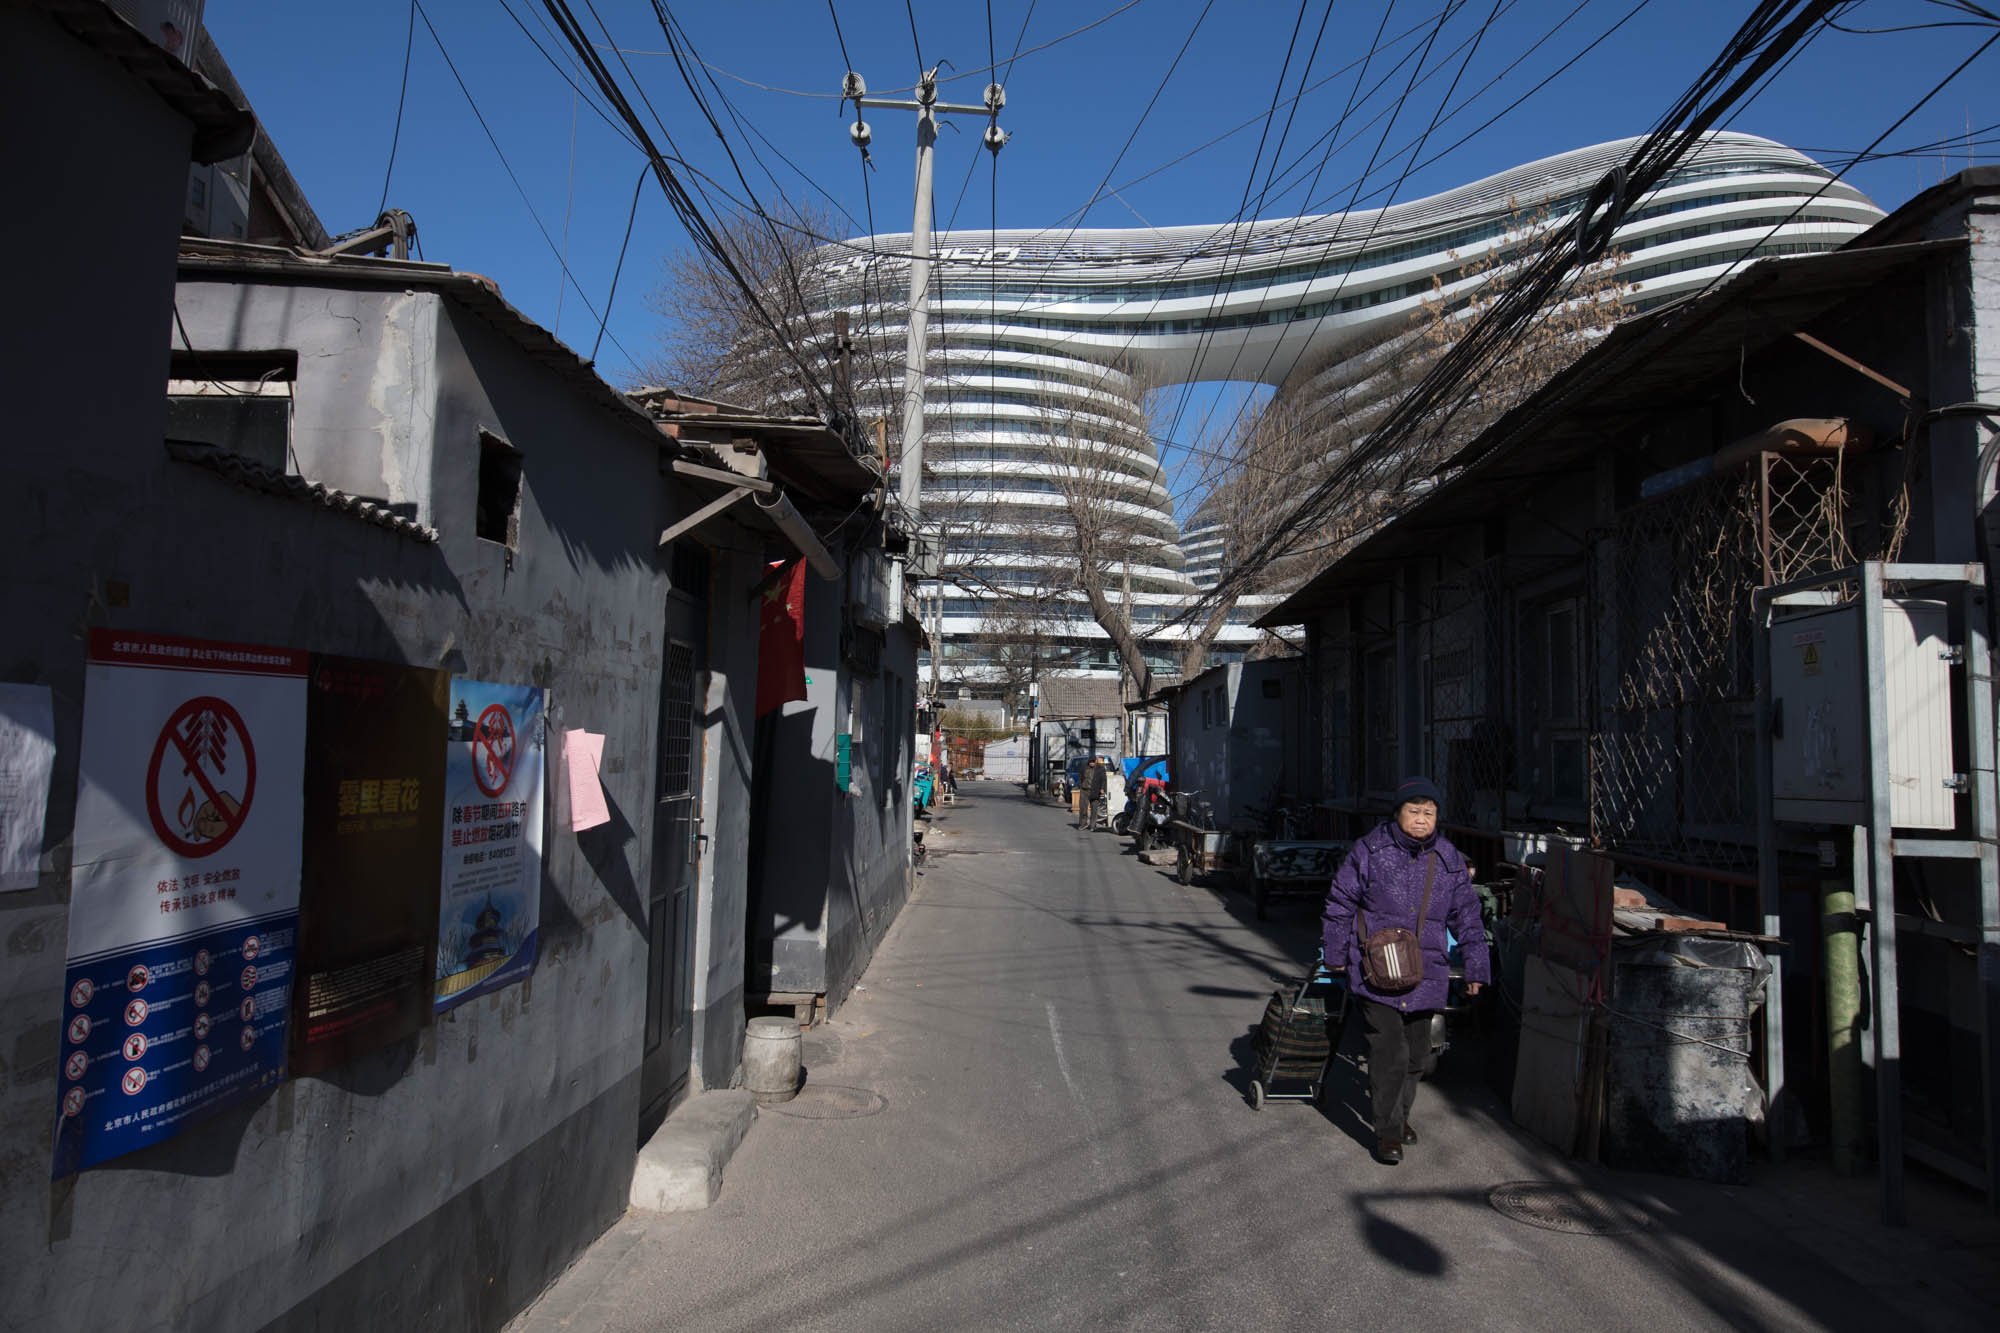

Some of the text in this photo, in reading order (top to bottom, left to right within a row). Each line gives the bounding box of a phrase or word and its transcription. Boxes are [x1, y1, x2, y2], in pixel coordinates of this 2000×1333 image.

[112, 641, 190, 658] 北京市人民政府
[338, 777, 420, 816] 雾里看花
[452, 801, 528, 825] 除春节期间五环路内
[157, 878, 179, 894] 依法
